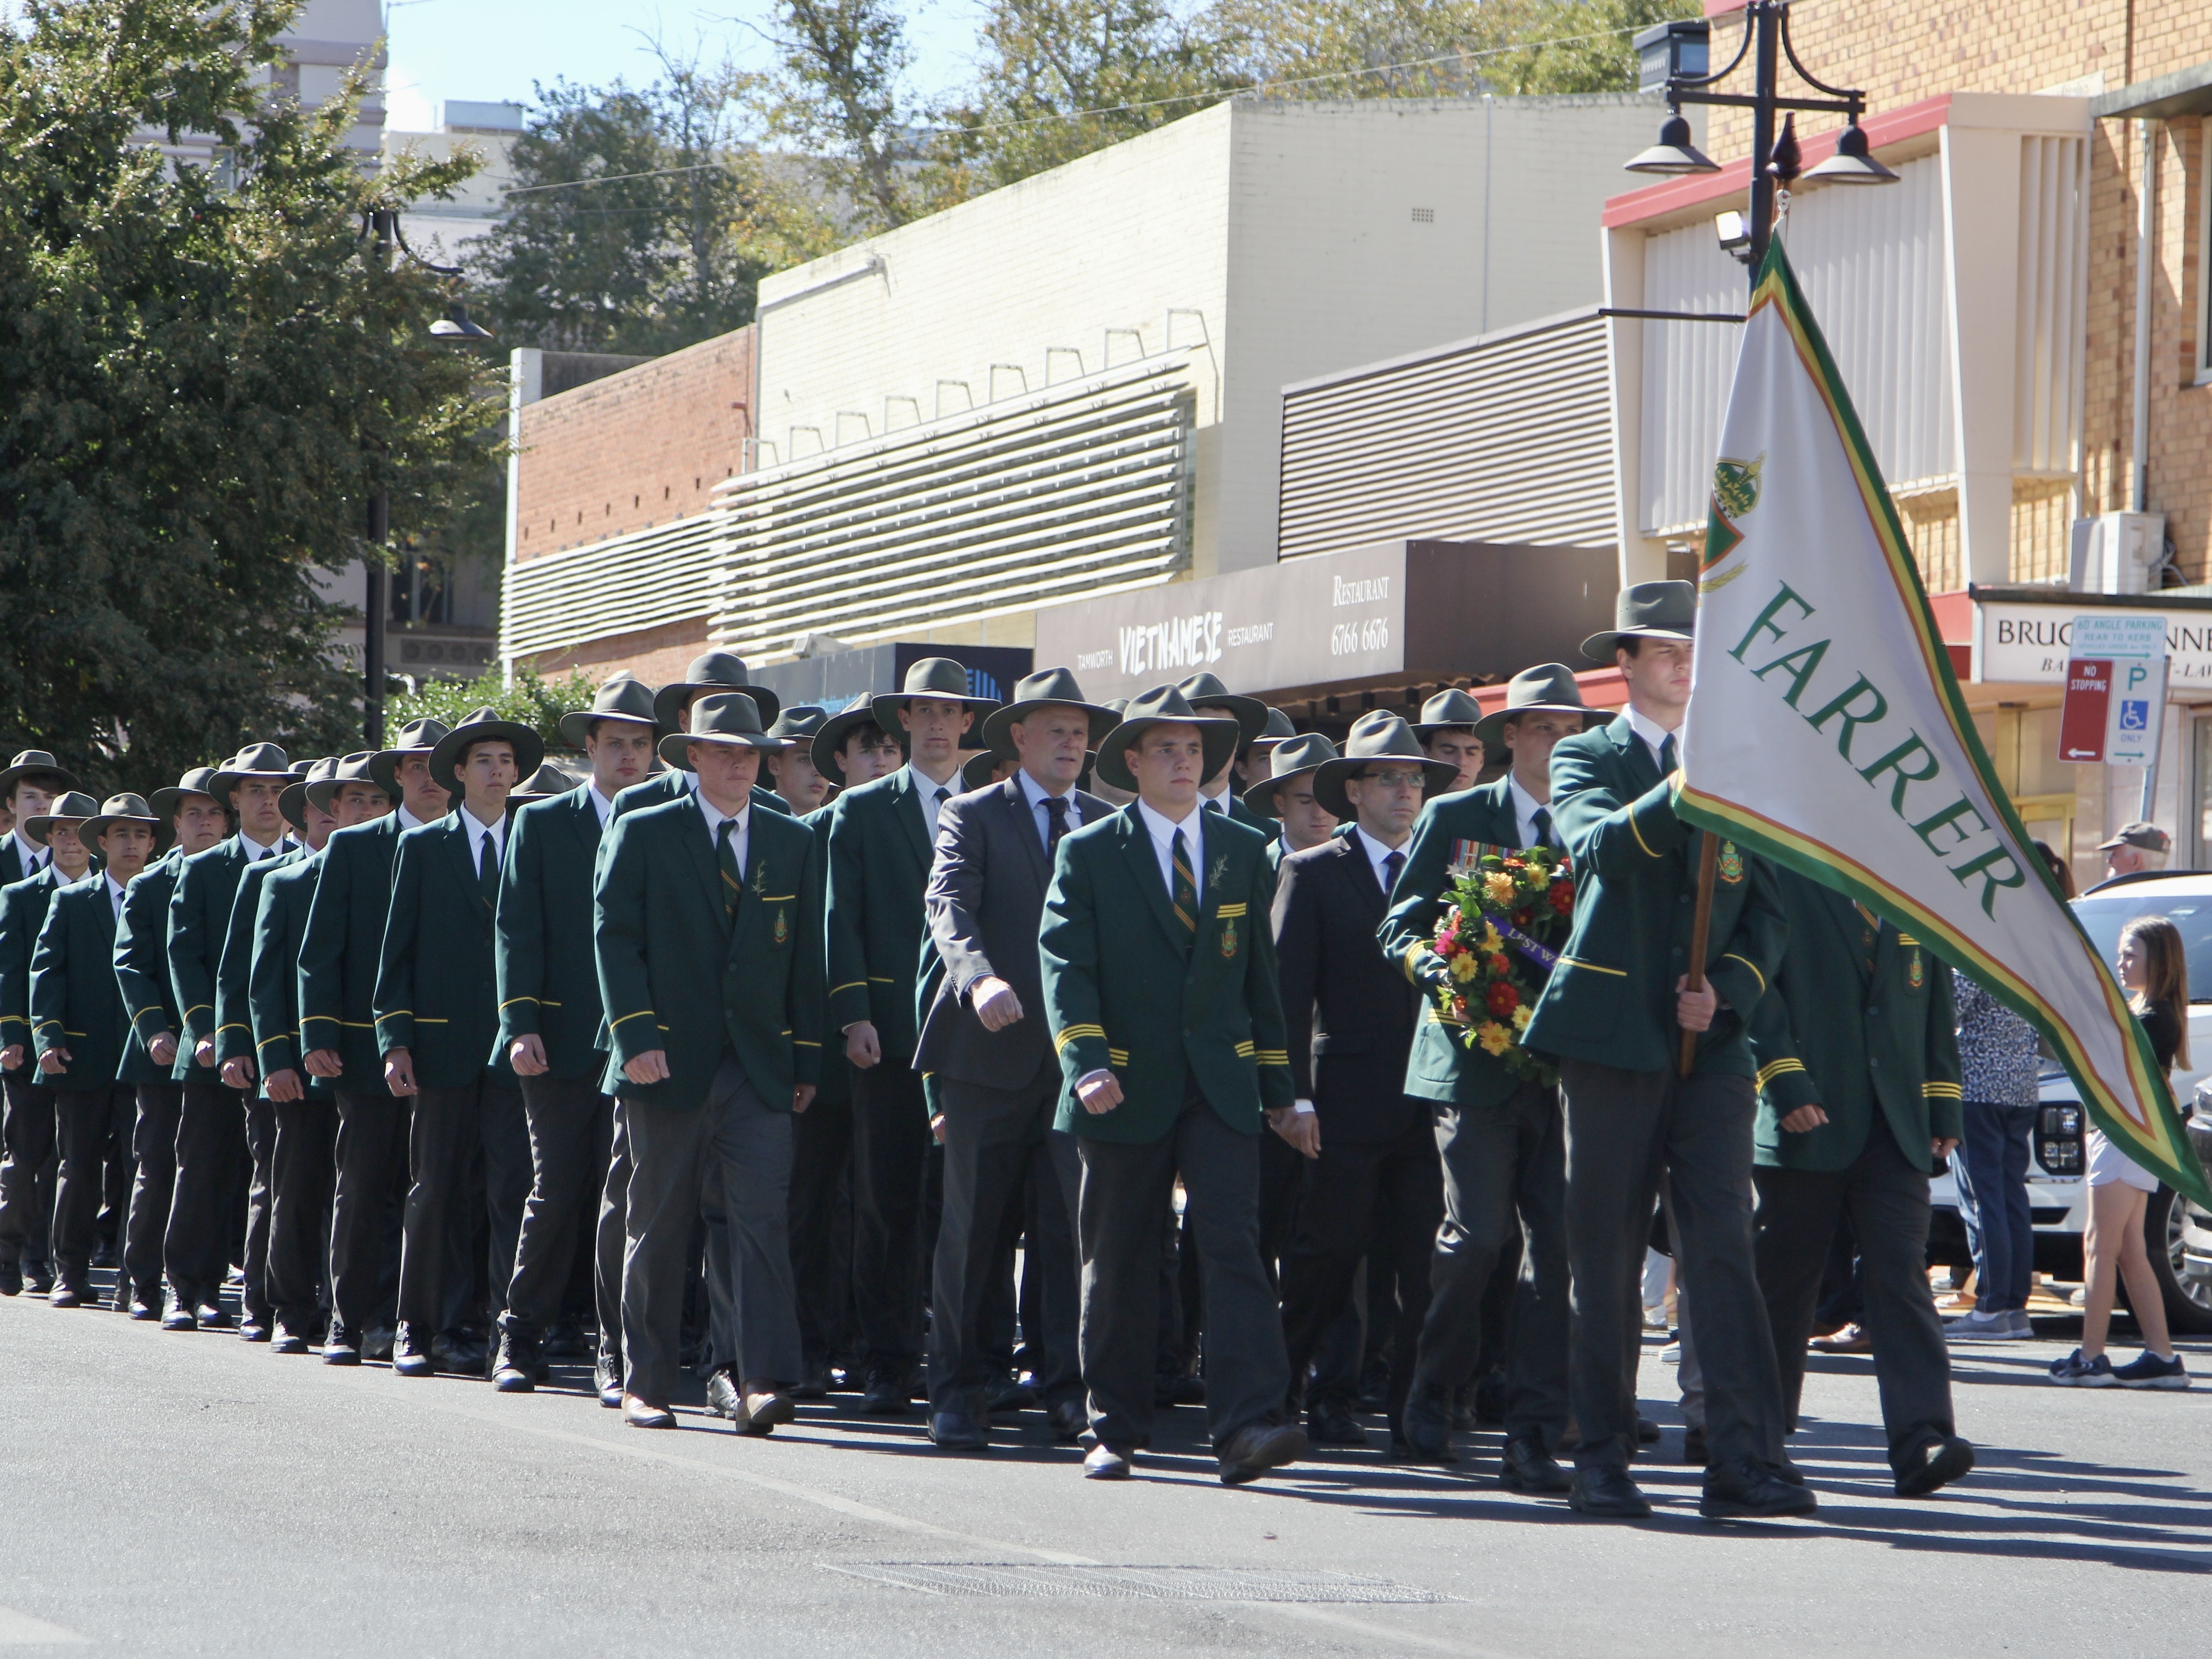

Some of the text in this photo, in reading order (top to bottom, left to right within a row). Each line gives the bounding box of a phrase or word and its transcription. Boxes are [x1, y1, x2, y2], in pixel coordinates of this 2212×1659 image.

[1334, 575, 1390, 607] RESTAURANT
[1332, 617, 1388, 656] 6766 6676
[1999, 620, 2073, 647] BRUC
[2093, 620, 2121, 630] ANGLE
[2125, 620, 2163, 630] PARKING
[1078, 611, 1274, 676] TAMWORTH VIETNAMESE RESTAURANT
[2083, 665, 2097, 677] NO
[2128, 667, 2147, 691] P
[2071, 679, 2107, 693] STOPPING
[1727, 579, 2026, 923] FARRER
[2121, 734, 2142, 743] ONLY
[1507, 927, 1541, 953] LEST
